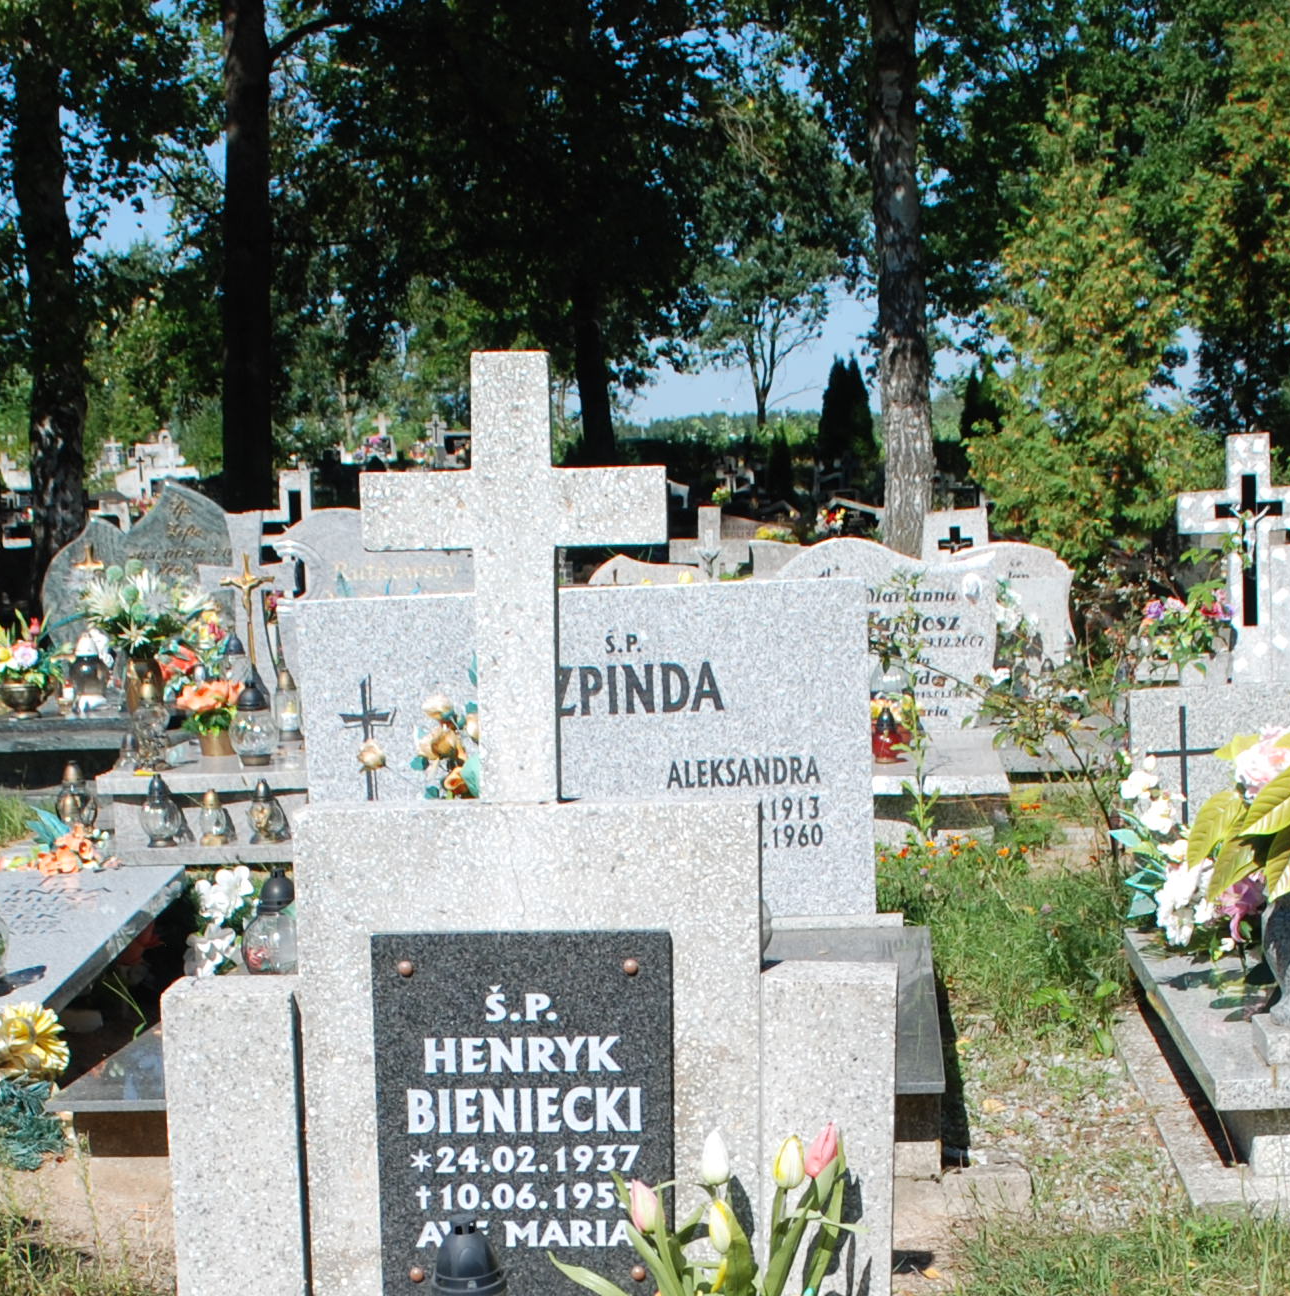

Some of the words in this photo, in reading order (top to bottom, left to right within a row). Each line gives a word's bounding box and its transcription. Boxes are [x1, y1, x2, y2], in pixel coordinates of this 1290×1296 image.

[559, 661, 725, 717] ZPINDA
[666, 756, 821, 789] ALEKSANDRA
[423, 1035, 622, 1074] HENRYK
[406, 1086, 643, 1134] BIENIECKI
[502, 1219, 635, 1248] MARIA
